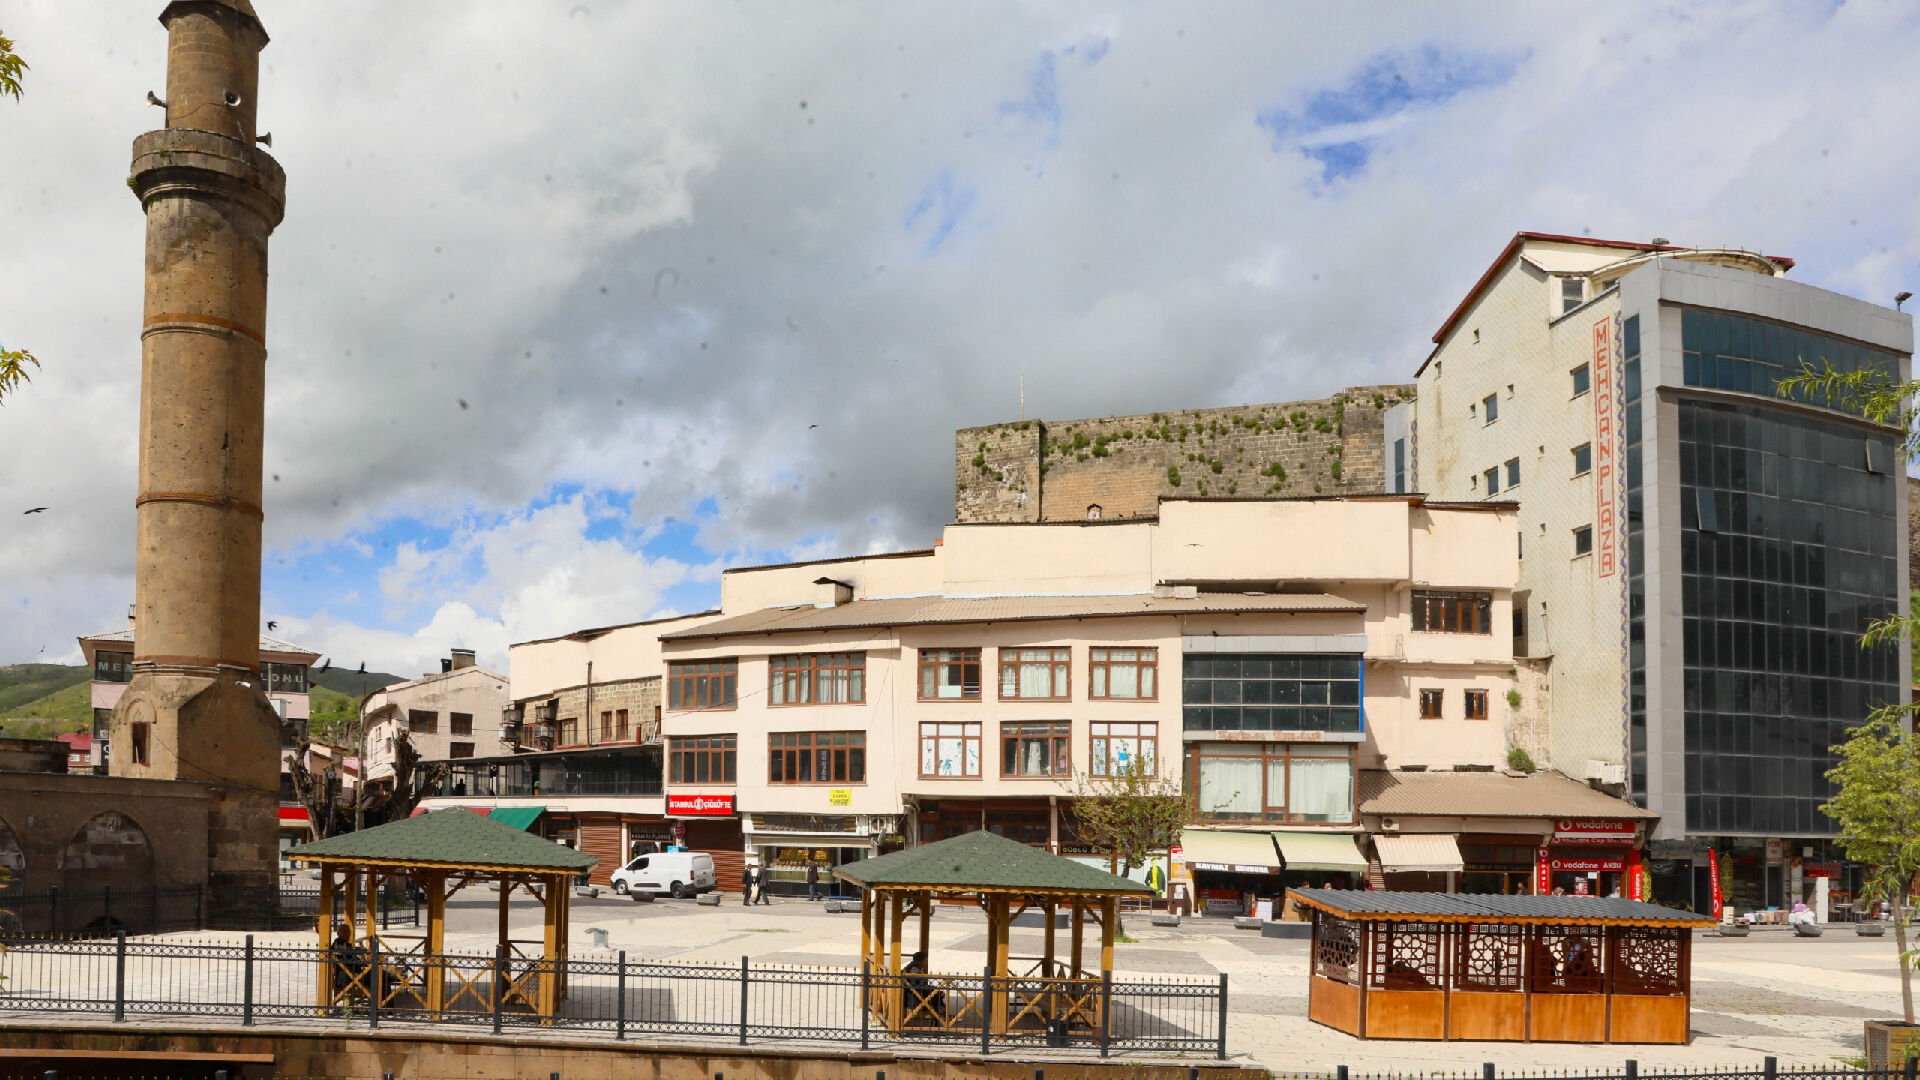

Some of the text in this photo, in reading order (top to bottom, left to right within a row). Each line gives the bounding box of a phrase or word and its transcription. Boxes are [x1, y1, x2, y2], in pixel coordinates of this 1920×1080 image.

[1596, 324, 1613, 573] MEHCAN PLAZA
[260, 672, 303, 683] LONU
[1576, 820, 1624, 830] vodafone
[1195, 862, 1229, 872] KAYMAZ
[1563, 861, 1599, 869] vodafone
